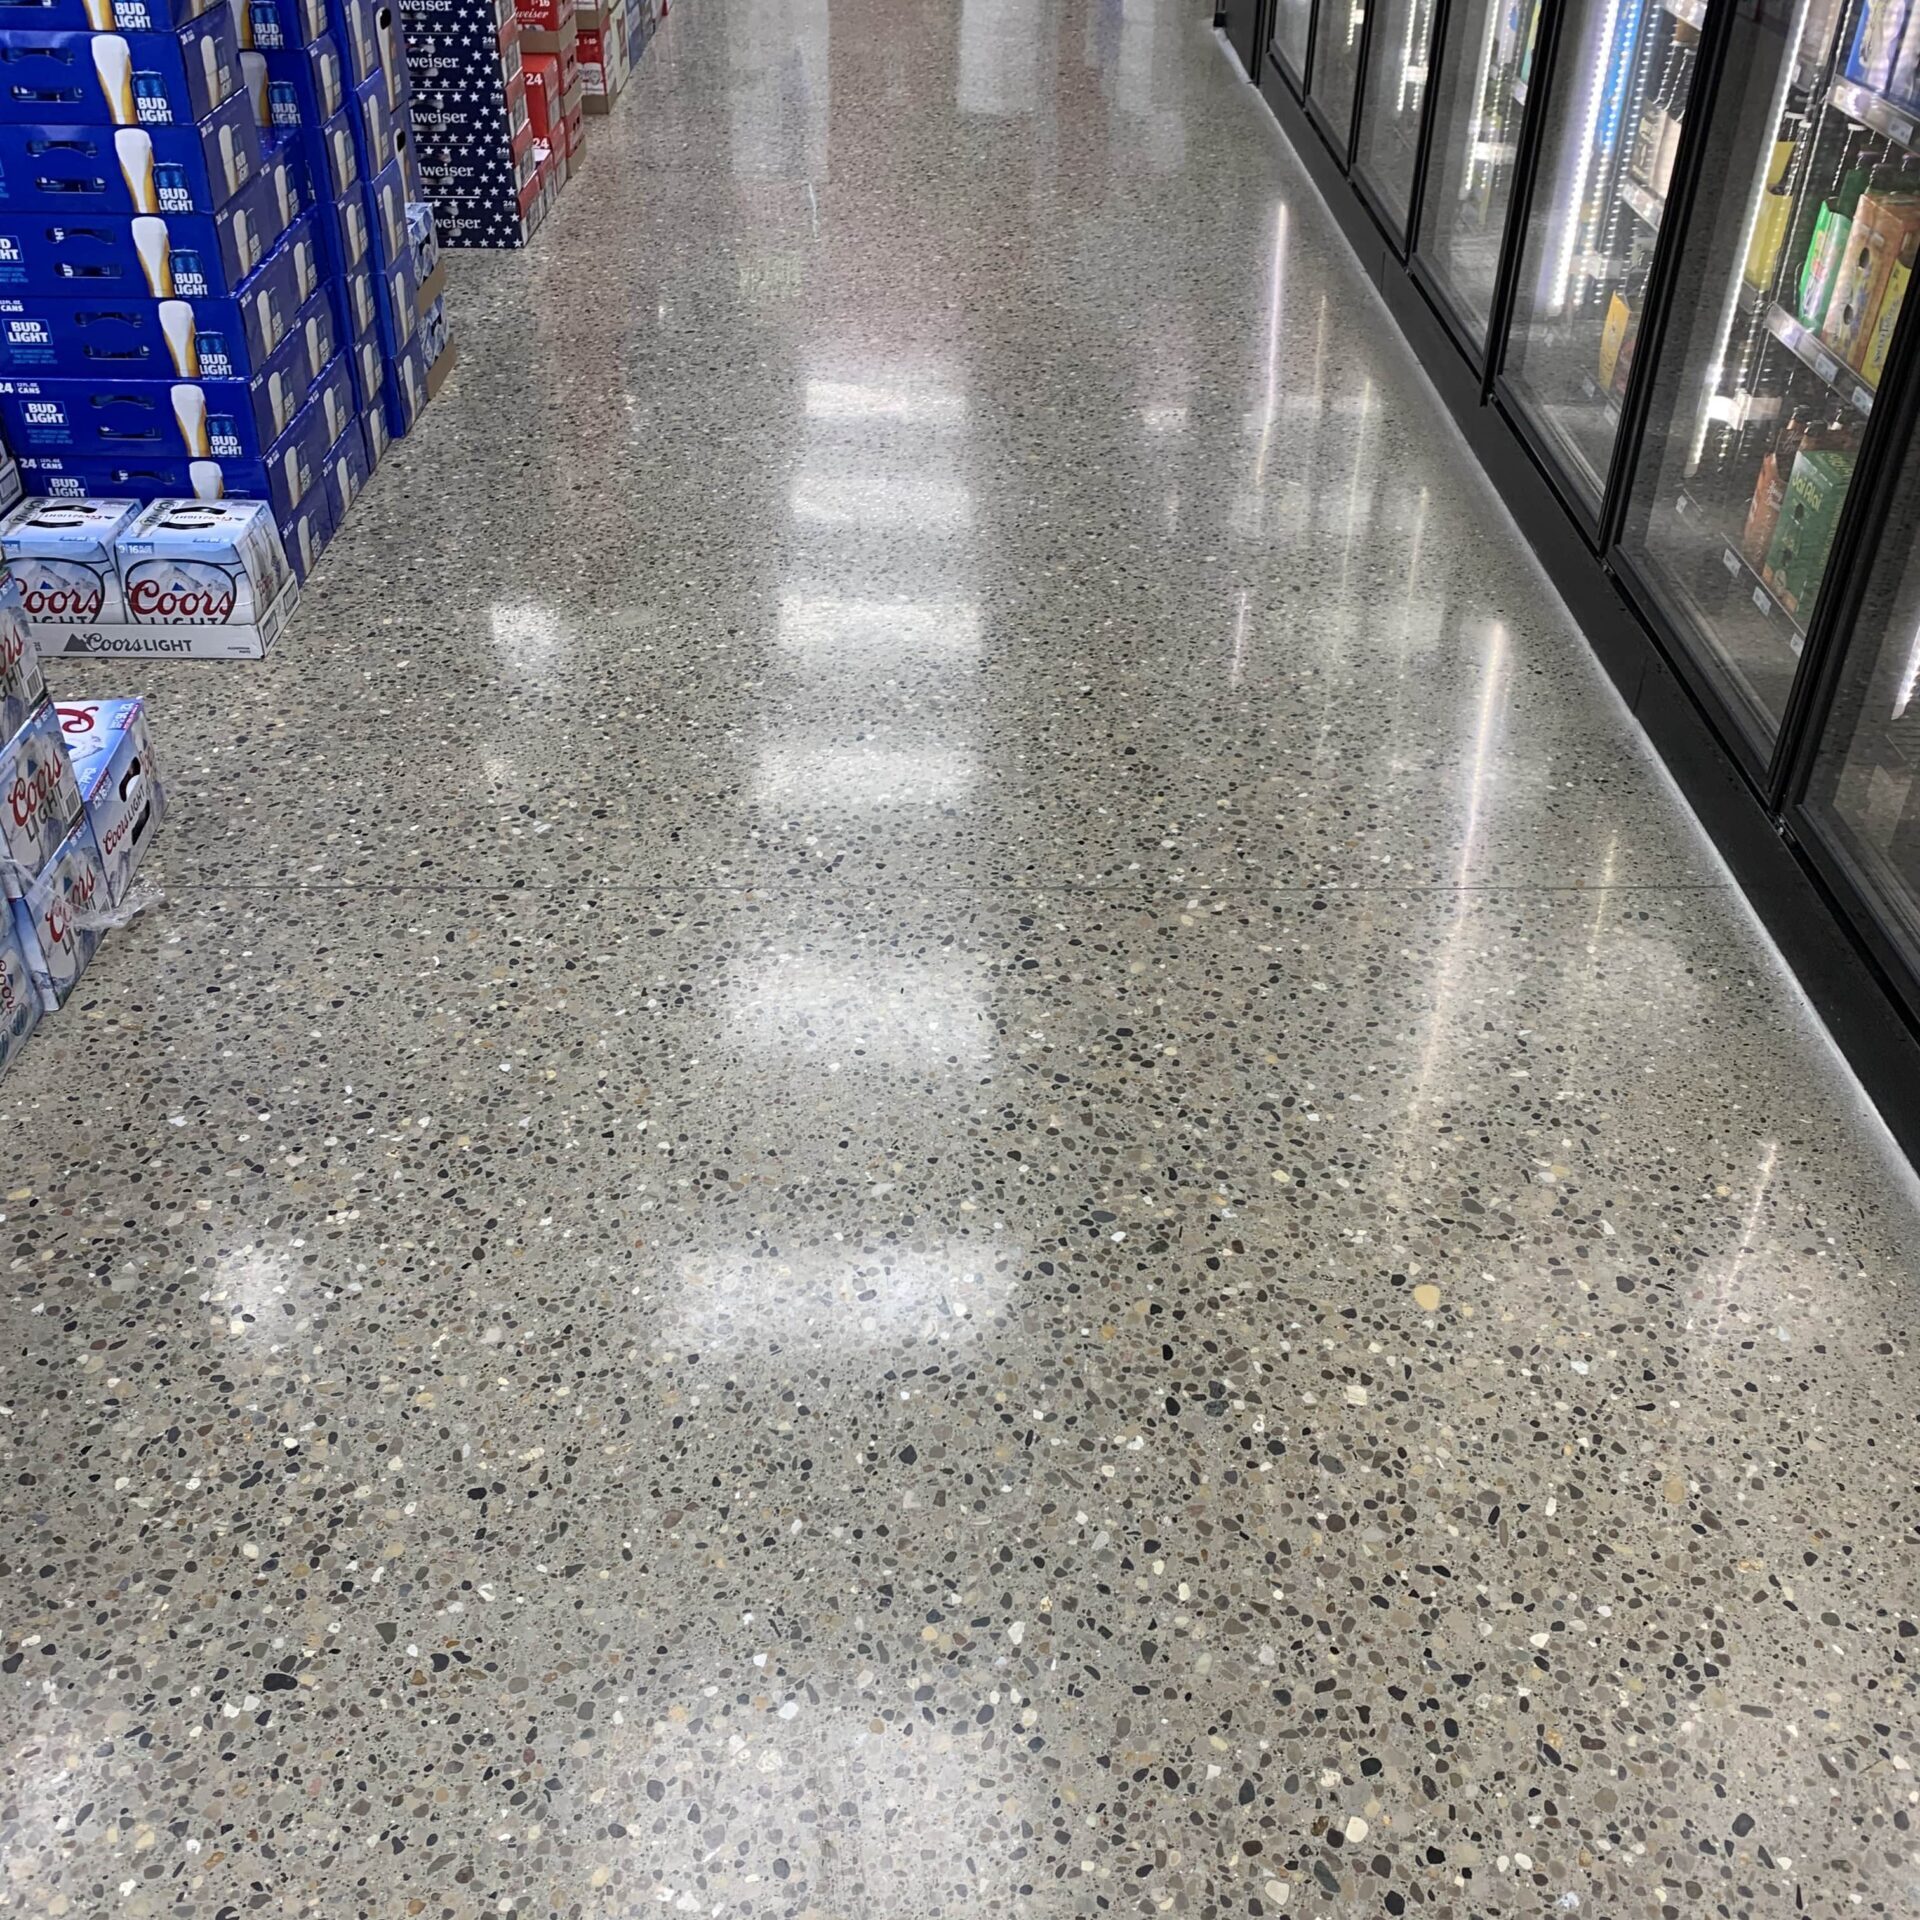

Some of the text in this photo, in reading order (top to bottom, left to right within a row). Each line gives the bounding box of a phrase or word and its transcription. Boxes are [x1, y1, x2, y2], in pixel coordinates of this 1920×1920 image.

[114, 2, 146, 15] BUD
[399, 0, 452, 11] weiser
[114, 16, 152, 28] LIGHT
[254, 23, 280, 34] BUD
[254, 34, 284, 46] LIGHT
[406, 53, 459, 68] weiser
[526, 73, 543, 86] 24
[137, 97, 167, 110] BUD
[272, 103, 297, 114] BUD
[137, 110, 173, 122] LIGHT
[410, 108, 468, 123] weiser
[532, 138, 549, 149] 24
[418, 162, 474, 177] weiser
[159, 188, 188, 200] BUD
[159, 200, 193, 211] LIGHT
[435, 215, 481, 229] weiser
[175, 273, 203, 284] BUD
[174, 284, 208, 295] LIGHT
[0, 304, 24, 312] CANS
[10, 321, 41, 332] BUD
[8, 332, 48, 343] LIGHT
[200, 354, 228, 364] BUD
[199, 364, 233, 375] LIGHT
[27, 403, 57, 413] BUD
[25, 413, 64, 424] LIGHT
[211, 436, 238, 446] BUD
[210, 446, 242, 455] LIGHT
[20, 458, 37, 469] 24
[50, 478, 79, 488] BUD
[48, 488, 86, 497] LIGHT
[128, 545, 139, 554] 16
[128, 579, 234, 616] Coors
[83, 633, 192, 652] Coors LIGHT
[8, 748, 62, 827] Coors
[25, 780, 63, 843] LIGHT
[103, 816, 130, 855] Coors
[128, 783, 147, 822] LIGHT
